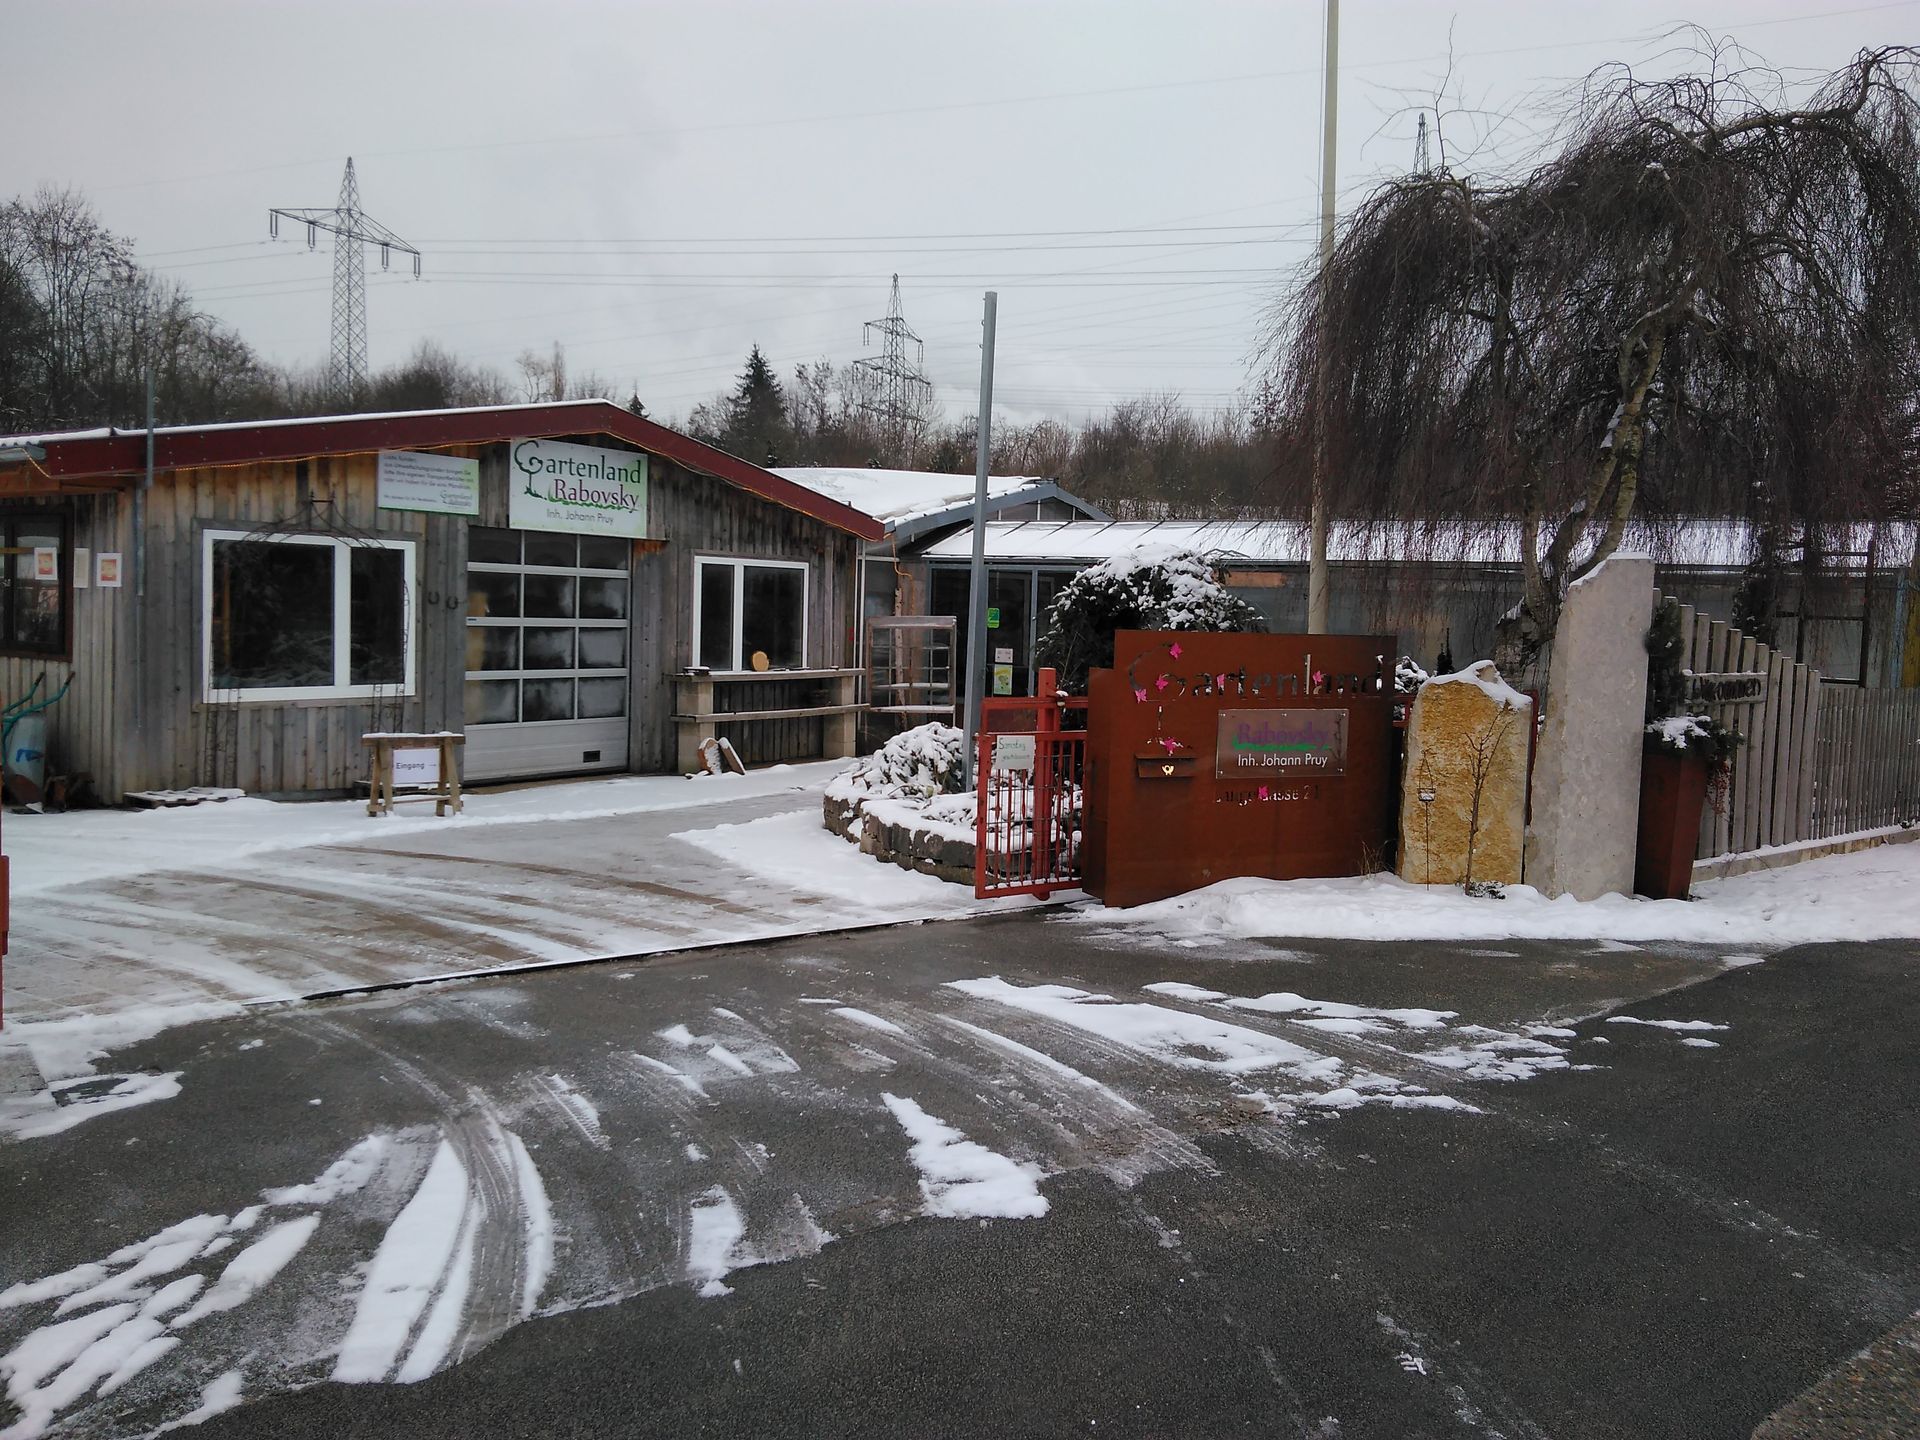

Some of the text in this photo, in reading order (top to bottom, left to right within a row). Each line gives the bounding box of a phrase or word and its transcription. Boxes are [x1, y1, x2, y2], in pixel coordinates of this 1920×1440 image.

[514, 440, 641, 484] Gartenland
[554, 478, 640, 514] Rabovsky
[565, 510, 596, 522] Johann
[395, 762, 425, 770] Eingang
[1238, 752, 1328, 768] Inh. Johann Pruy
